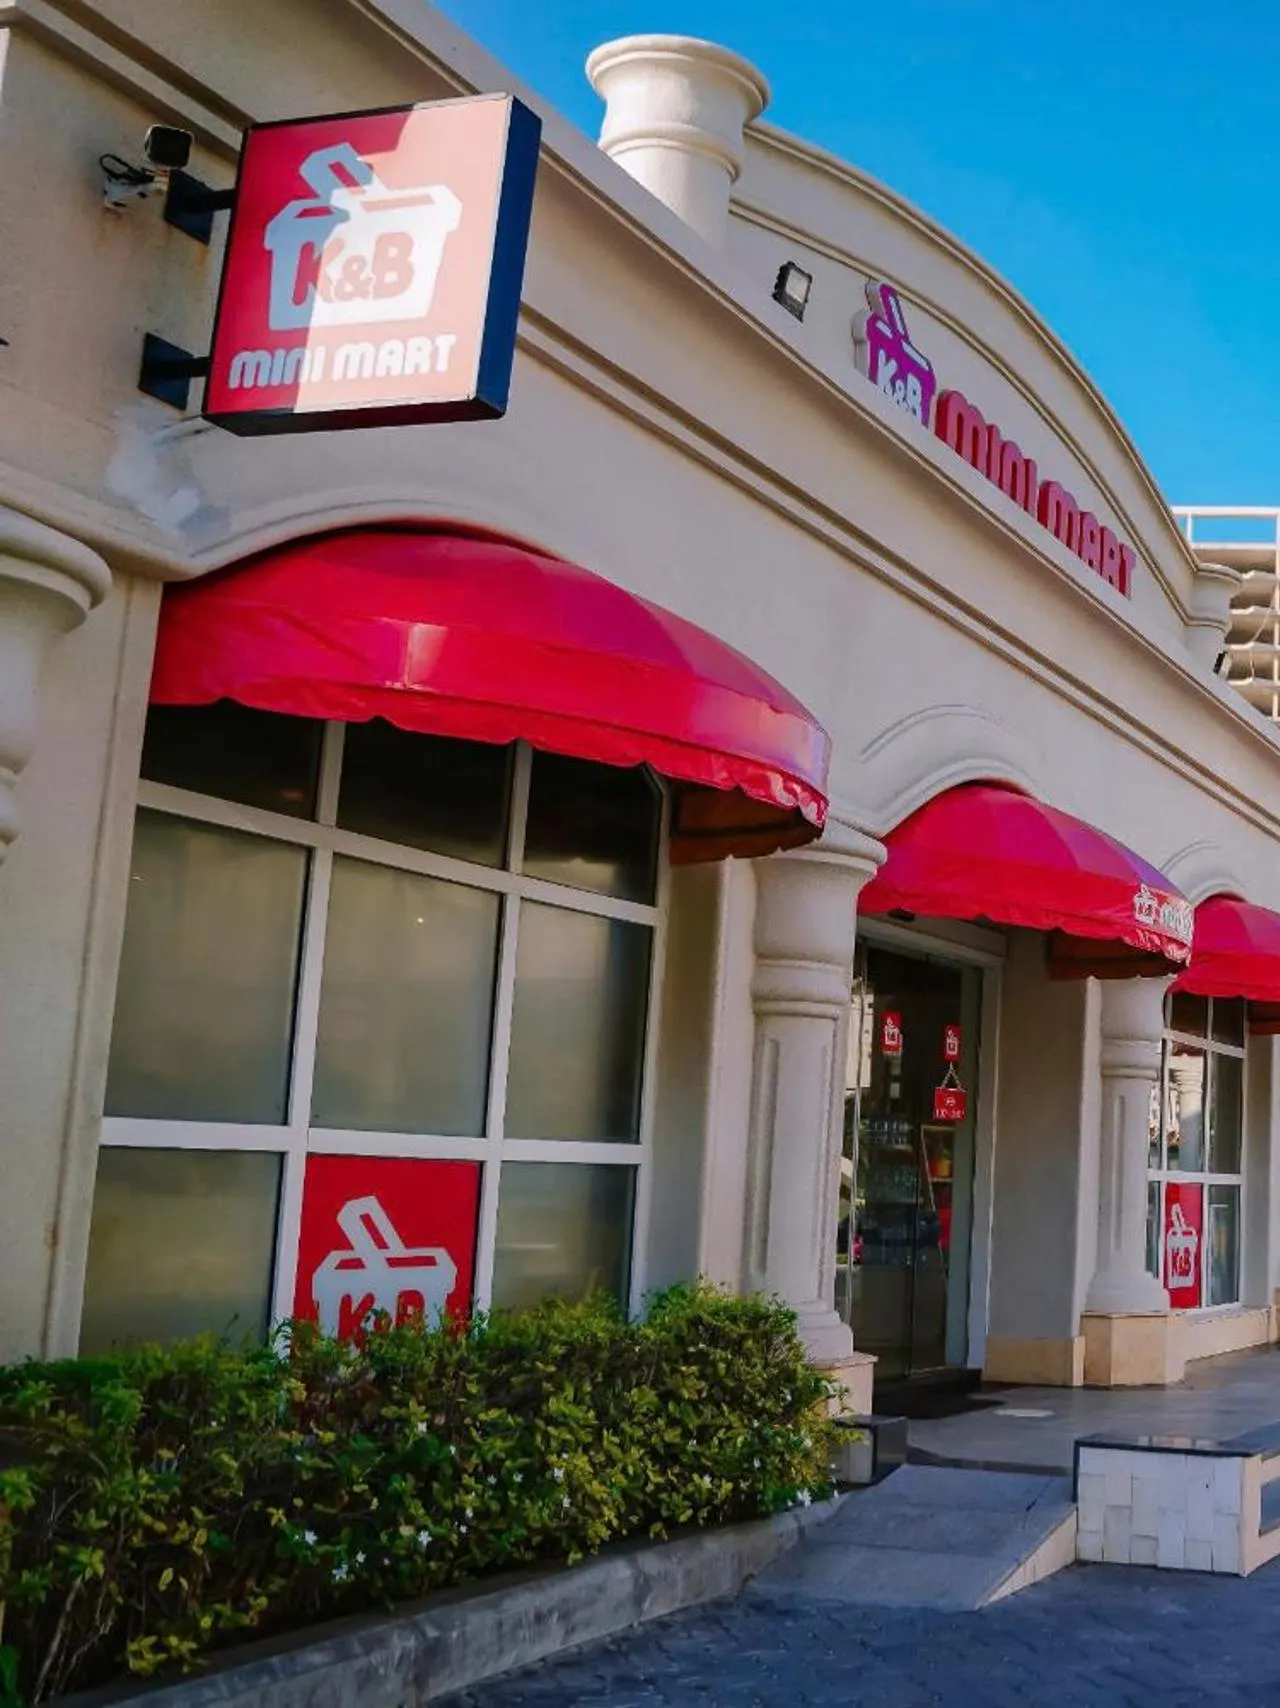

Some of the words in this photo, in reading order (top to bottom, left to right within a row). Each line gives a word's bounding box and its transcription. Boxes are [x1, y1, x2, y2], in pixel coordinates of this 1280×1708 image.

[292, 232, 415, 305] K&B
[228, 347, 325, 389] MINI
[332, 334, 458, 381] MART
[878, 349, 922, 421] K&B
[937, 390, 1037, 516] MINI
[1037, 481, 1136, 600] MART
